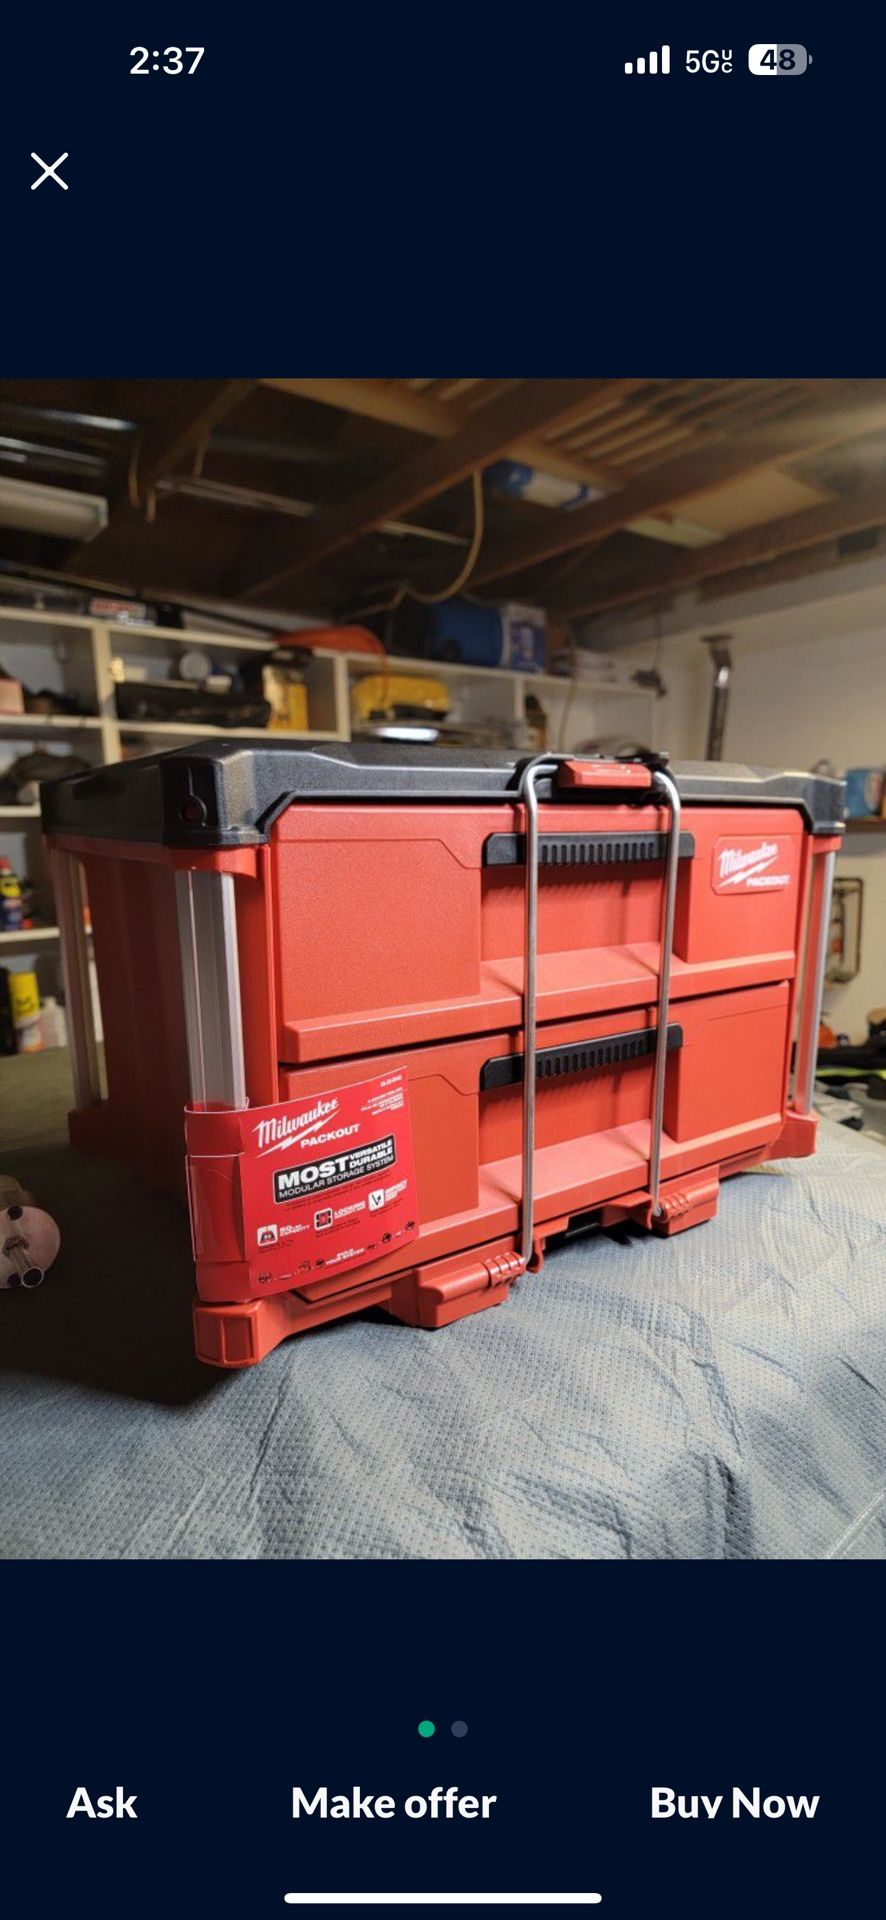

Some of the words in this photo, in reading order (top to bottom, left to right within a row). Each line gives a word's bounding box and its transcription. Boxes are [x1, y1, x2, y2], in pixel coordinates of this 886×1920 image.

[129, 46, 205, 75] 2:37
[759, 48, 797, 71] 48
[718, 841, 778, 879] Milwaukee
[746, 874, 790, 888] PACKOUT
[252, 1097, 339, 1149] Milwaukee
[300, 1123, 360, 1149] PACKOUT
[277, 1156, 349, 1191] MOST
[349, 1139, 393, 1160] VERSATILE
[349, 1147, 393, 1169] DURABLE
[278, 1180, 325, 1199] MODULAR
[327, 1167, 365, 1185] STORAGE
[366, 1154, 394, 1171] SYSTEM
[65, 1786, 138, 1819] Ask
[292, 1786, 396, 1819] Make
[404, 1786, 498, 1819] offer
[651, 1786, 724, 1819] Buy
[732, 1786, 821, 1819] Now
